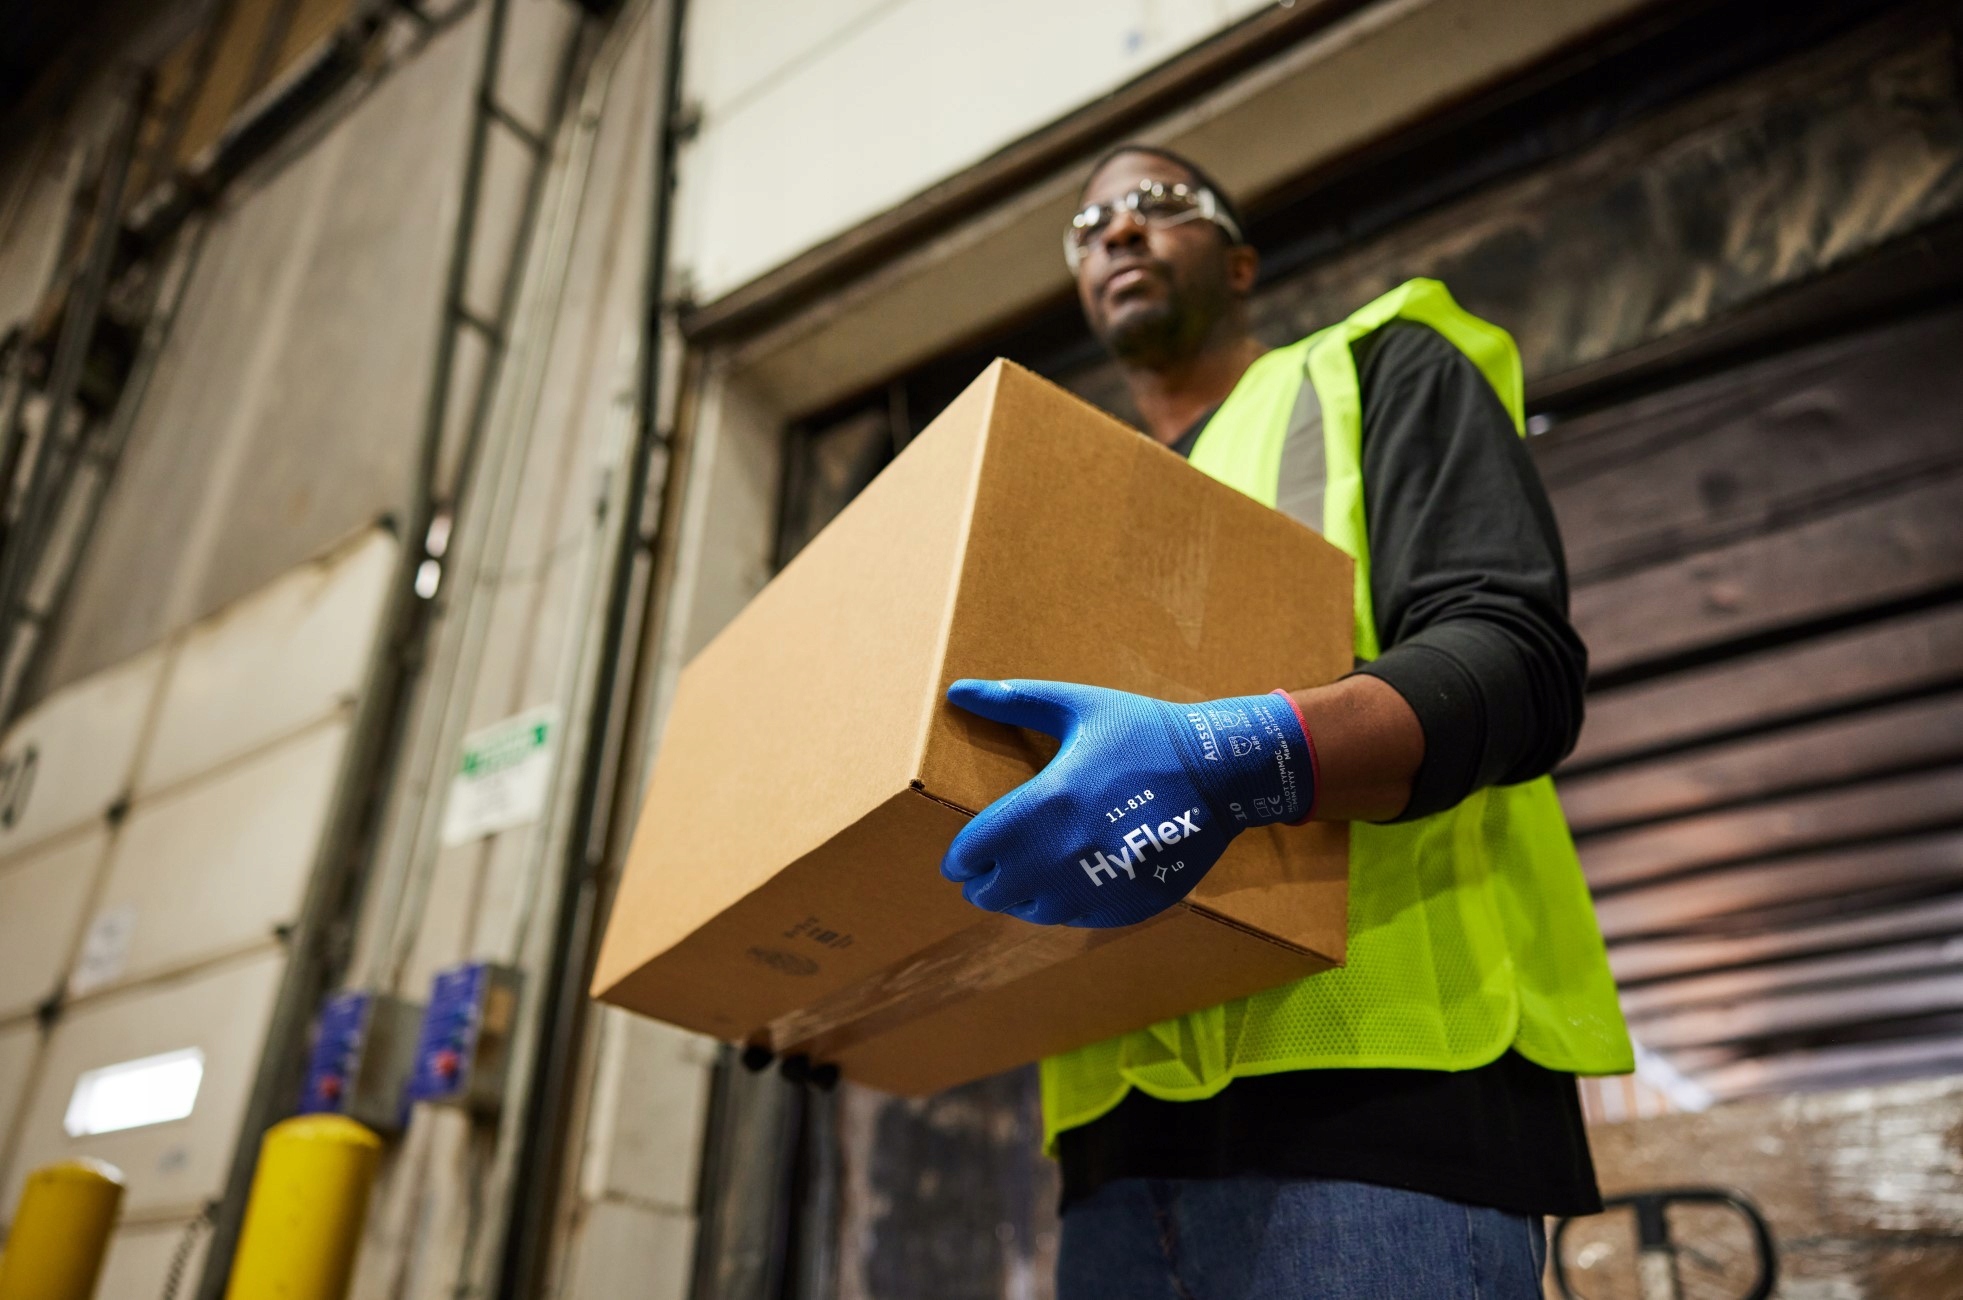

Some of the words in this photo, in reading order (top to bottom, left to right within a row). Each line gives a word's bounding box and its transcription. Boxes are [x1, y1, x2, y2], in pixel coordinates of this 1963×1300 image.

[1187, 711, 1218, 761] Ansell
[1231, 736, 1241, 754] ANSI
[1281, 740, 1291, 760] Made
[1275, 750, 1288, 784] YYMMOC
[1106, 789, 1154, 823] 11-818
[1229, 802, 1248, 820] 10
[1171, 860, 1185, 872] LD
